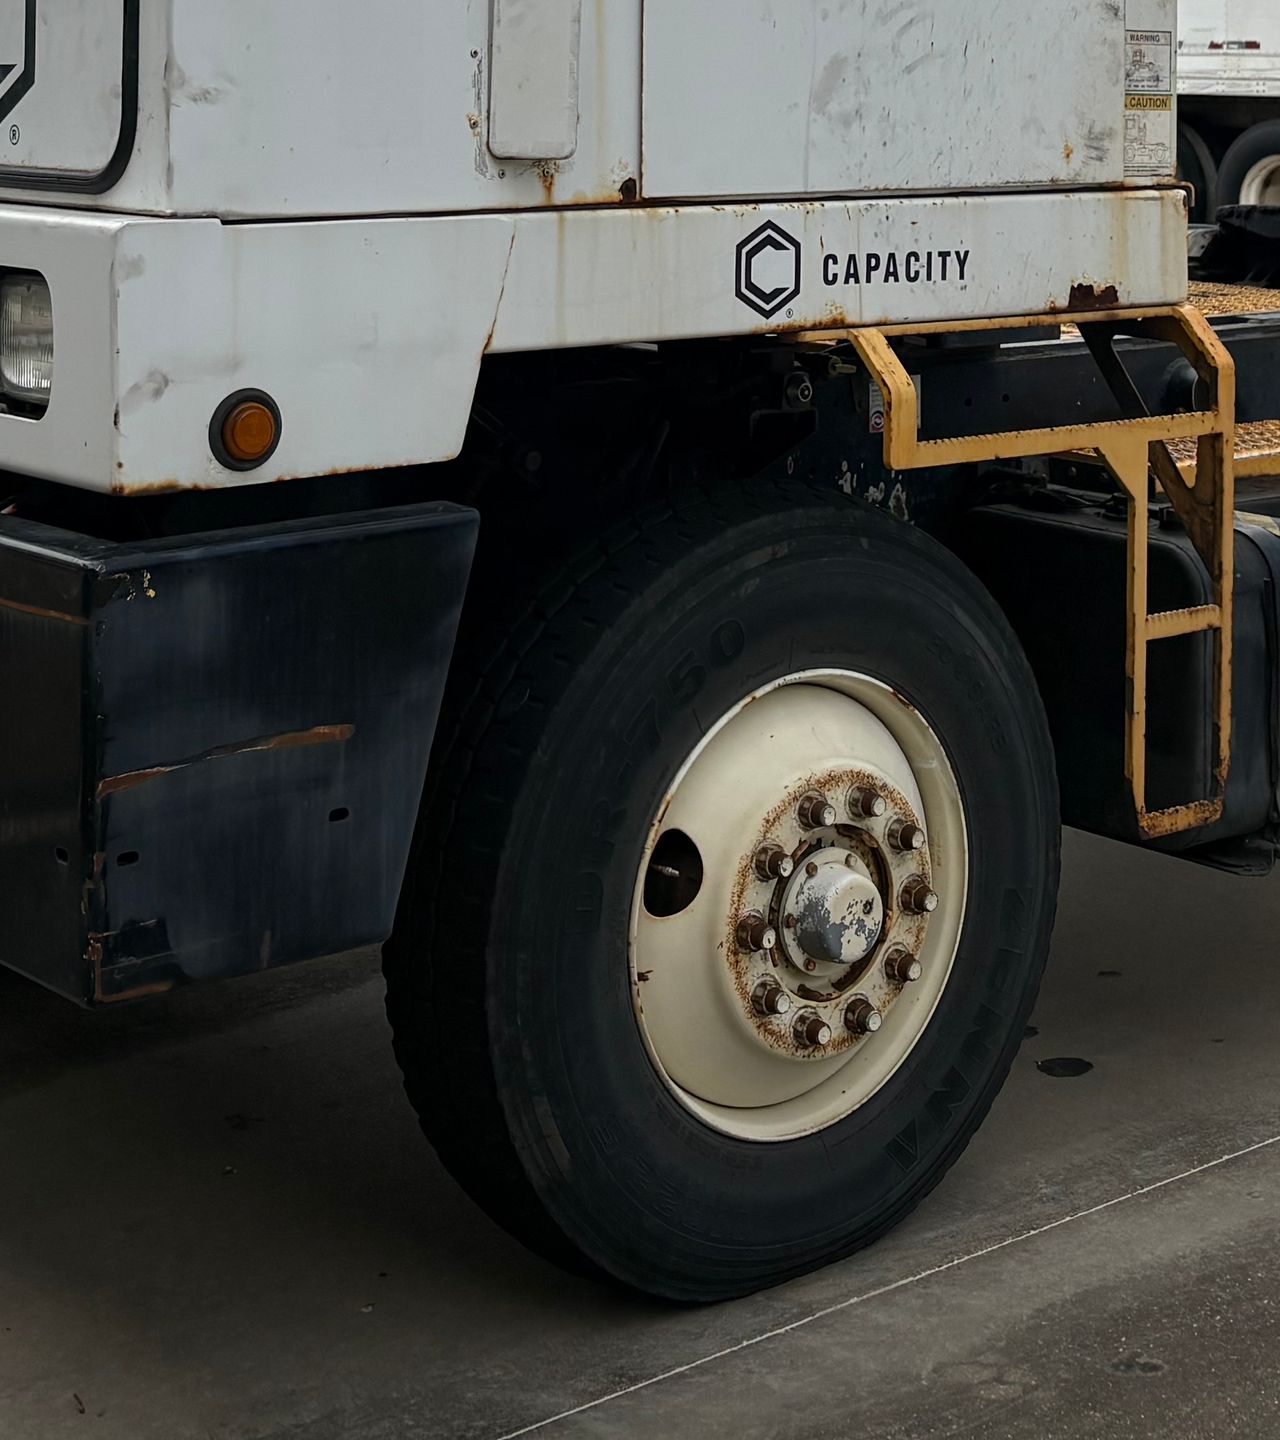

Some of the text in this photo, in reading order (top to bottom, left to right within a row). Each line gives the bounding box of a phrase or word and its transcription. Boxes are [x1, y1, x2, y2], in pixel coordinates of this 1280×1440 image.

[1129, 33, 1160, 43] WARNING
[1129, 97, 1168, 108] CAUTION
[822, 250, 970, 286] CAPACITY
